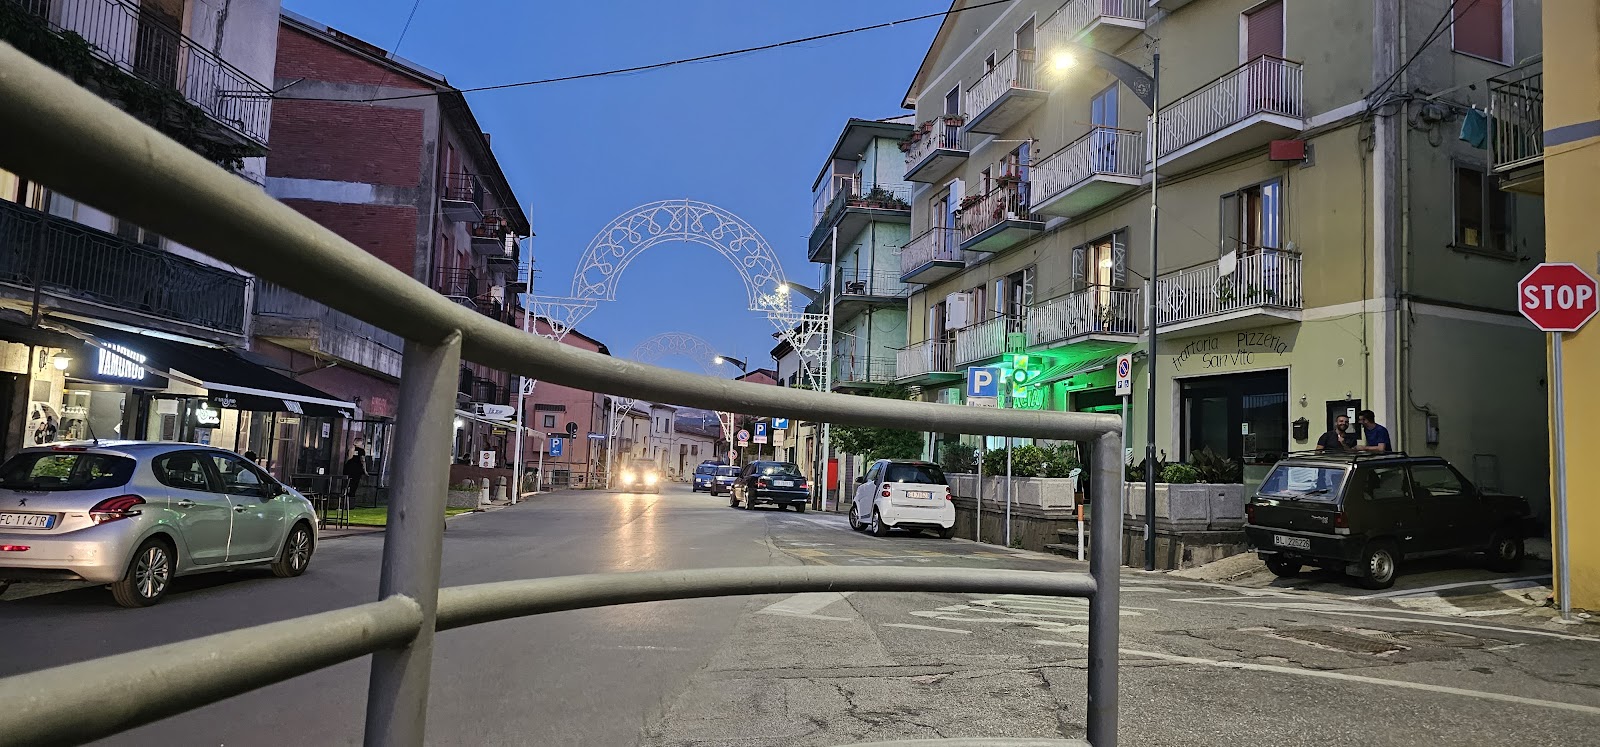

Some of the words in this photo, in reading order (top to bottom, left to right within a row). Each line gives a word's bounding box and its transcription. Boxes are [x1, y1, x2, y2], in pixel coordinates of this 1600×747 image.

[1524, 285, 1593, 310] STOP
[1237, 332, 1288, 357] Pizzeria
[1202, 353, 1227, 369] San
[1229, 349, 1255, 366] Vito
[974, 371, 992, 394] P
[756, 424, 764, 435] P
[552, 438, 560, 448] P
